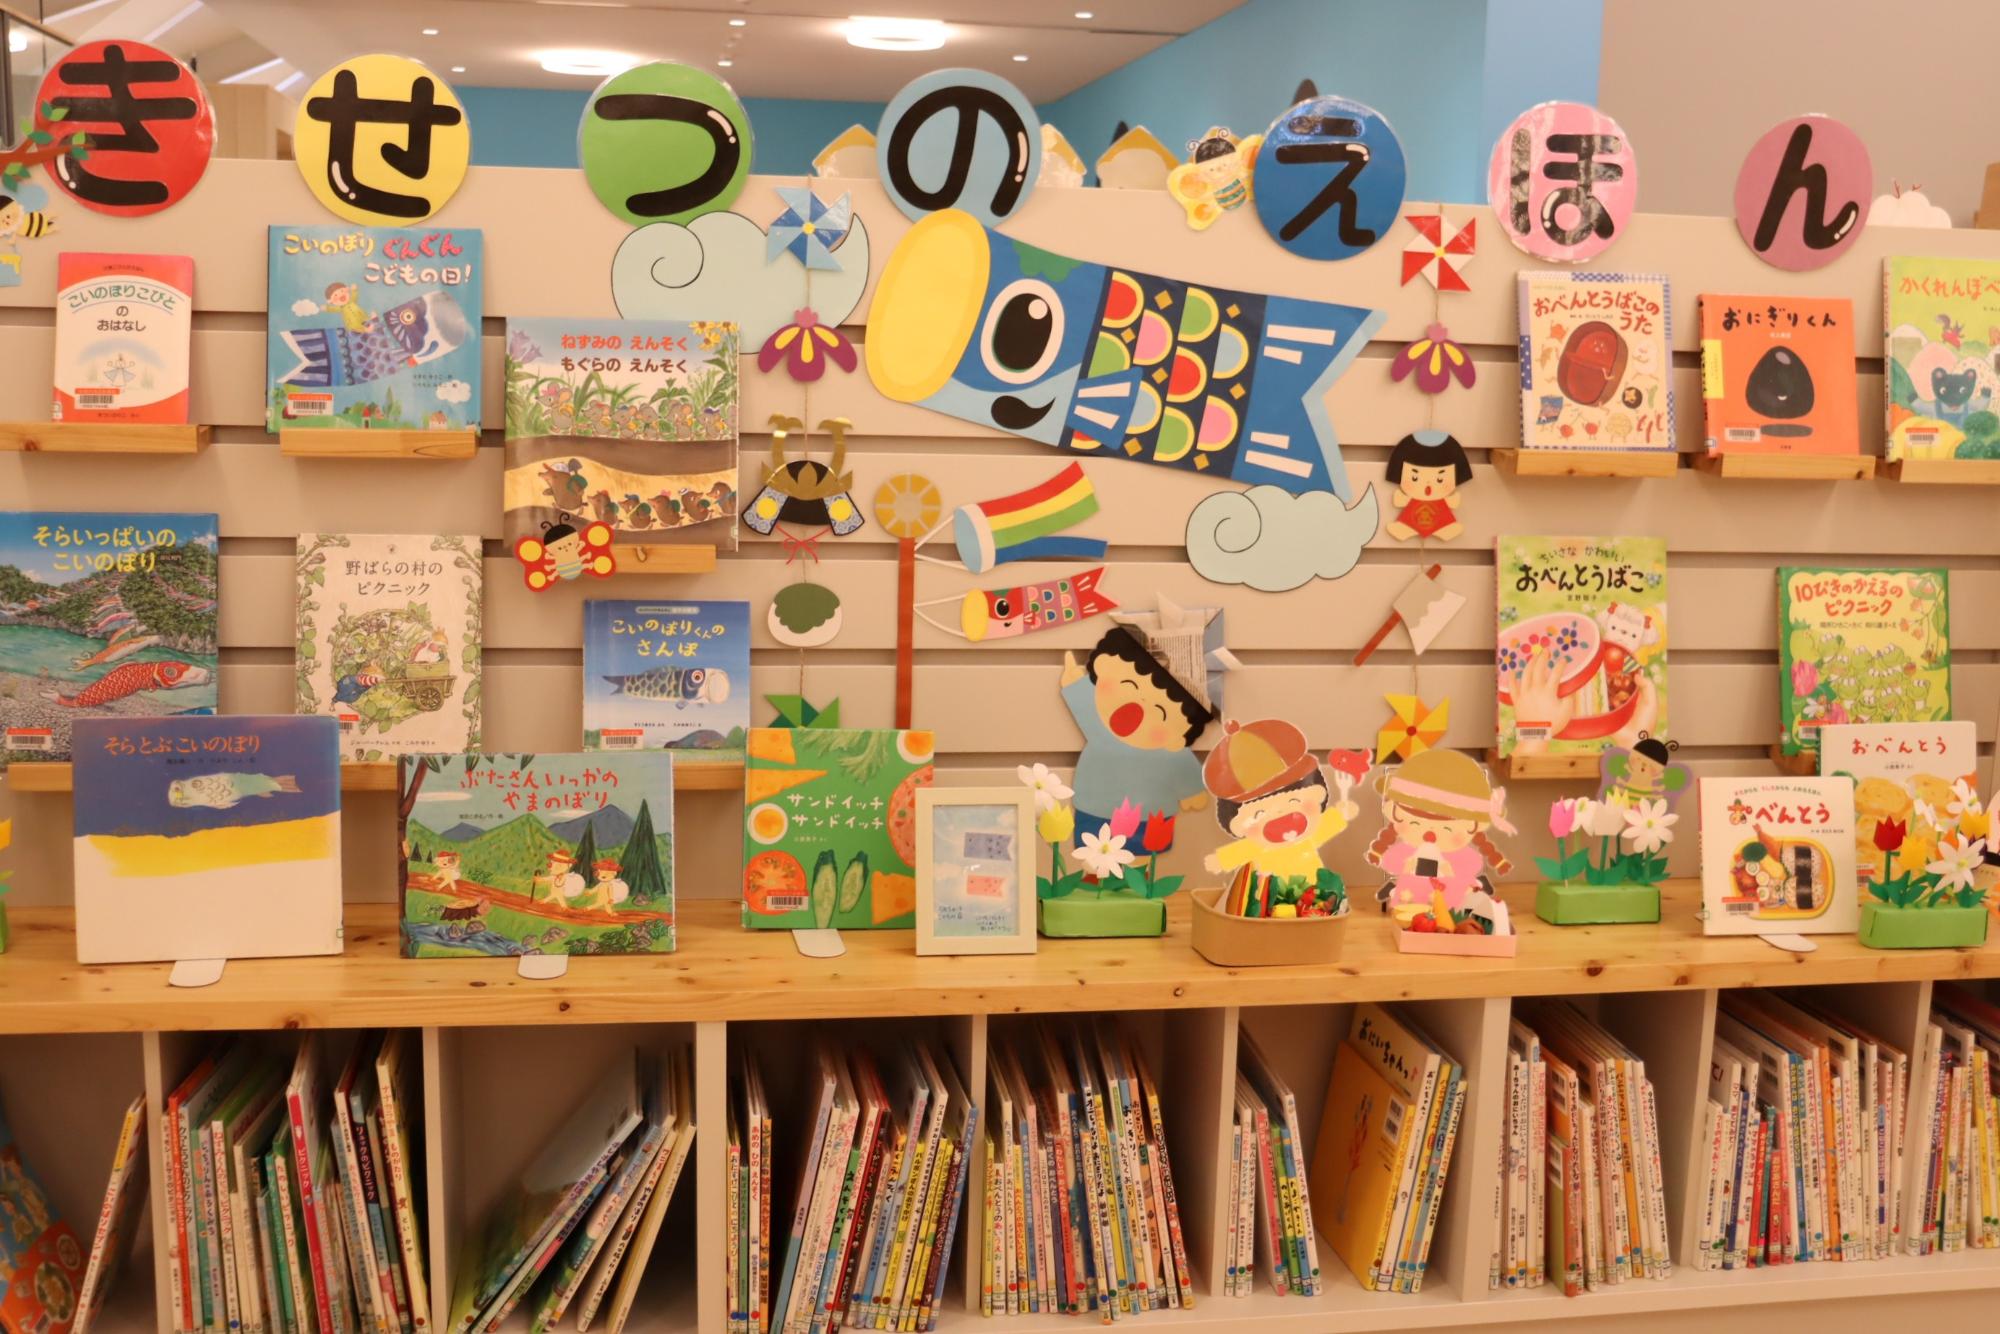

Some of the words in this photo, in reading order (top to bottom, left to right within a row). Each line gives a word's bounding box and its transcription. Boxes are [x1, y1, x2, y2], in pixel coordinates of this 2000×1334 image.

[50, 44, 197, 206] き
[306, 69, 462, 218] せ
[594, 93, 741, 217] つ
[887, 86, 1029, 217] の
[1275, 116, 1376, 246] え
[1753, 123, 1859, 252] ん
[284, 233, 375, 257] こいのぼり
[383, 232, 464, 260] ぐんぐん
[116, 305, 129, 317] の
[1533, 290, 1661, 318] おべんとうばこの
[97, 319, 146, 332] おはなし
[1619, 310, 1653, 336] うた
[1722, 305, 1837, 332] おにぎりくん
[561, 334, 622, 350] ねずみの
[630, 335, 689, 351] えんそく
[561, 356, 622, 372] もぐらの
[629, 357, 688, 373] えんそく
[33, 526, 177, 548] そらいっぱいの
[53, 552, 156, 573] こいのぼり
[346, 560, 443, 576] 野ばらの村の
[357, 582, 431, 596] ピクニック
[1516, 564, 1645, 593] おべんとうばこ
[1825, 599, 1893, 617] ピクニック
[612, 619, 726, 640] こいのぼりくんの
[636, 639, 700, 657] さんぽ
[1851, 736, 1947, 755] おべんとう
[503, 791, 609, 812] やまのぼり
[787, 793, 884, 810] サンドイッチ
[792, 814, 884, 830] サンドイッチ
[298, 1146, 309, 1188] ピクニック
[751, 1170, 760, 1200] えんそく
